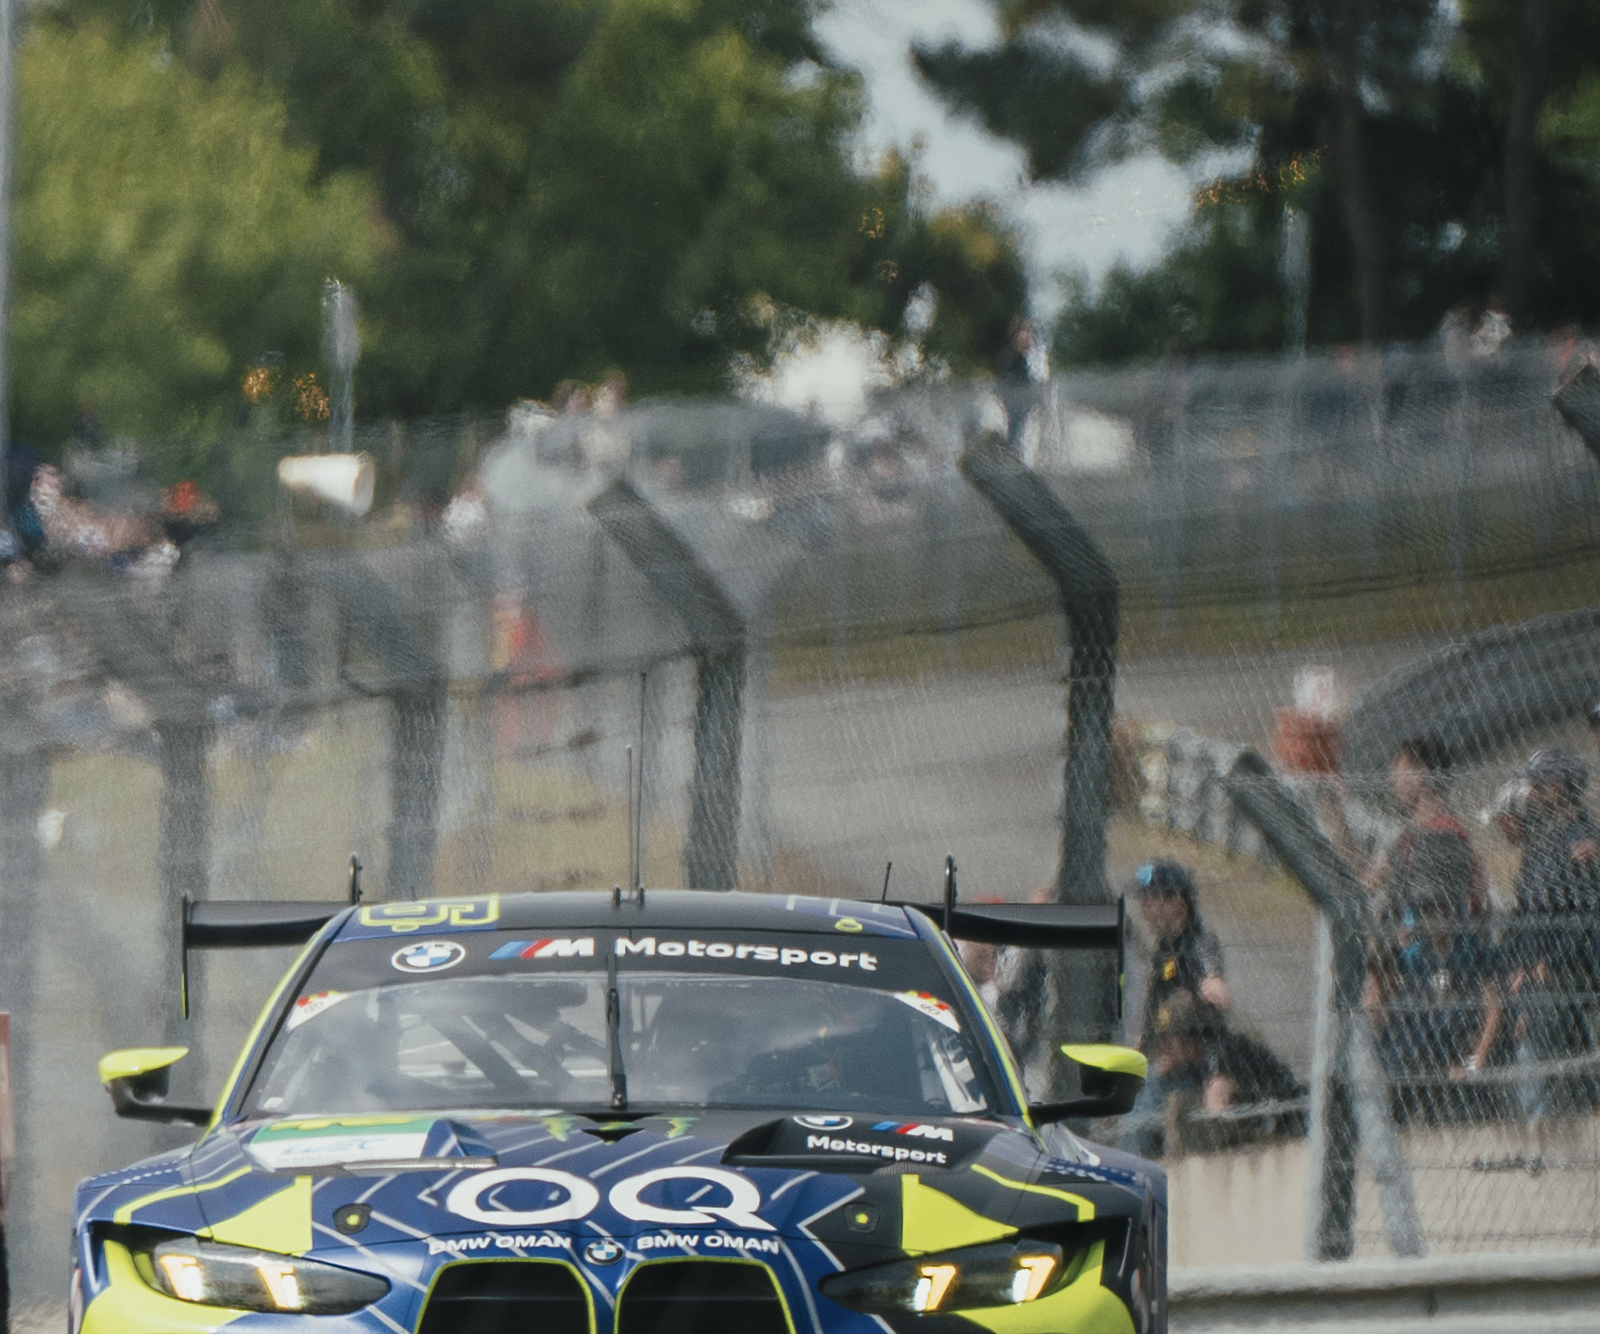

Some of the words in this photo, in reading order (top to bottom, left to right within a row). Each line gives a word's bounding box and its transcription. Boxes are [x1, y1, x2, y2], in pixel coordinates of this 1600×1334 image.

[533, 937, 595, 957] M
[614, 937, 878, 971] Motorsport
[806, 1134, 947, 1164] Motorsport
[446, 1166, 778, 1231] OQ
[428, 1236, 491, 1255] BMW
[495, 1235, 572, 1249] OMAN
[636, 1234, 699, 1250] BMW
[704, 1234, 780, 1255] OMAN
